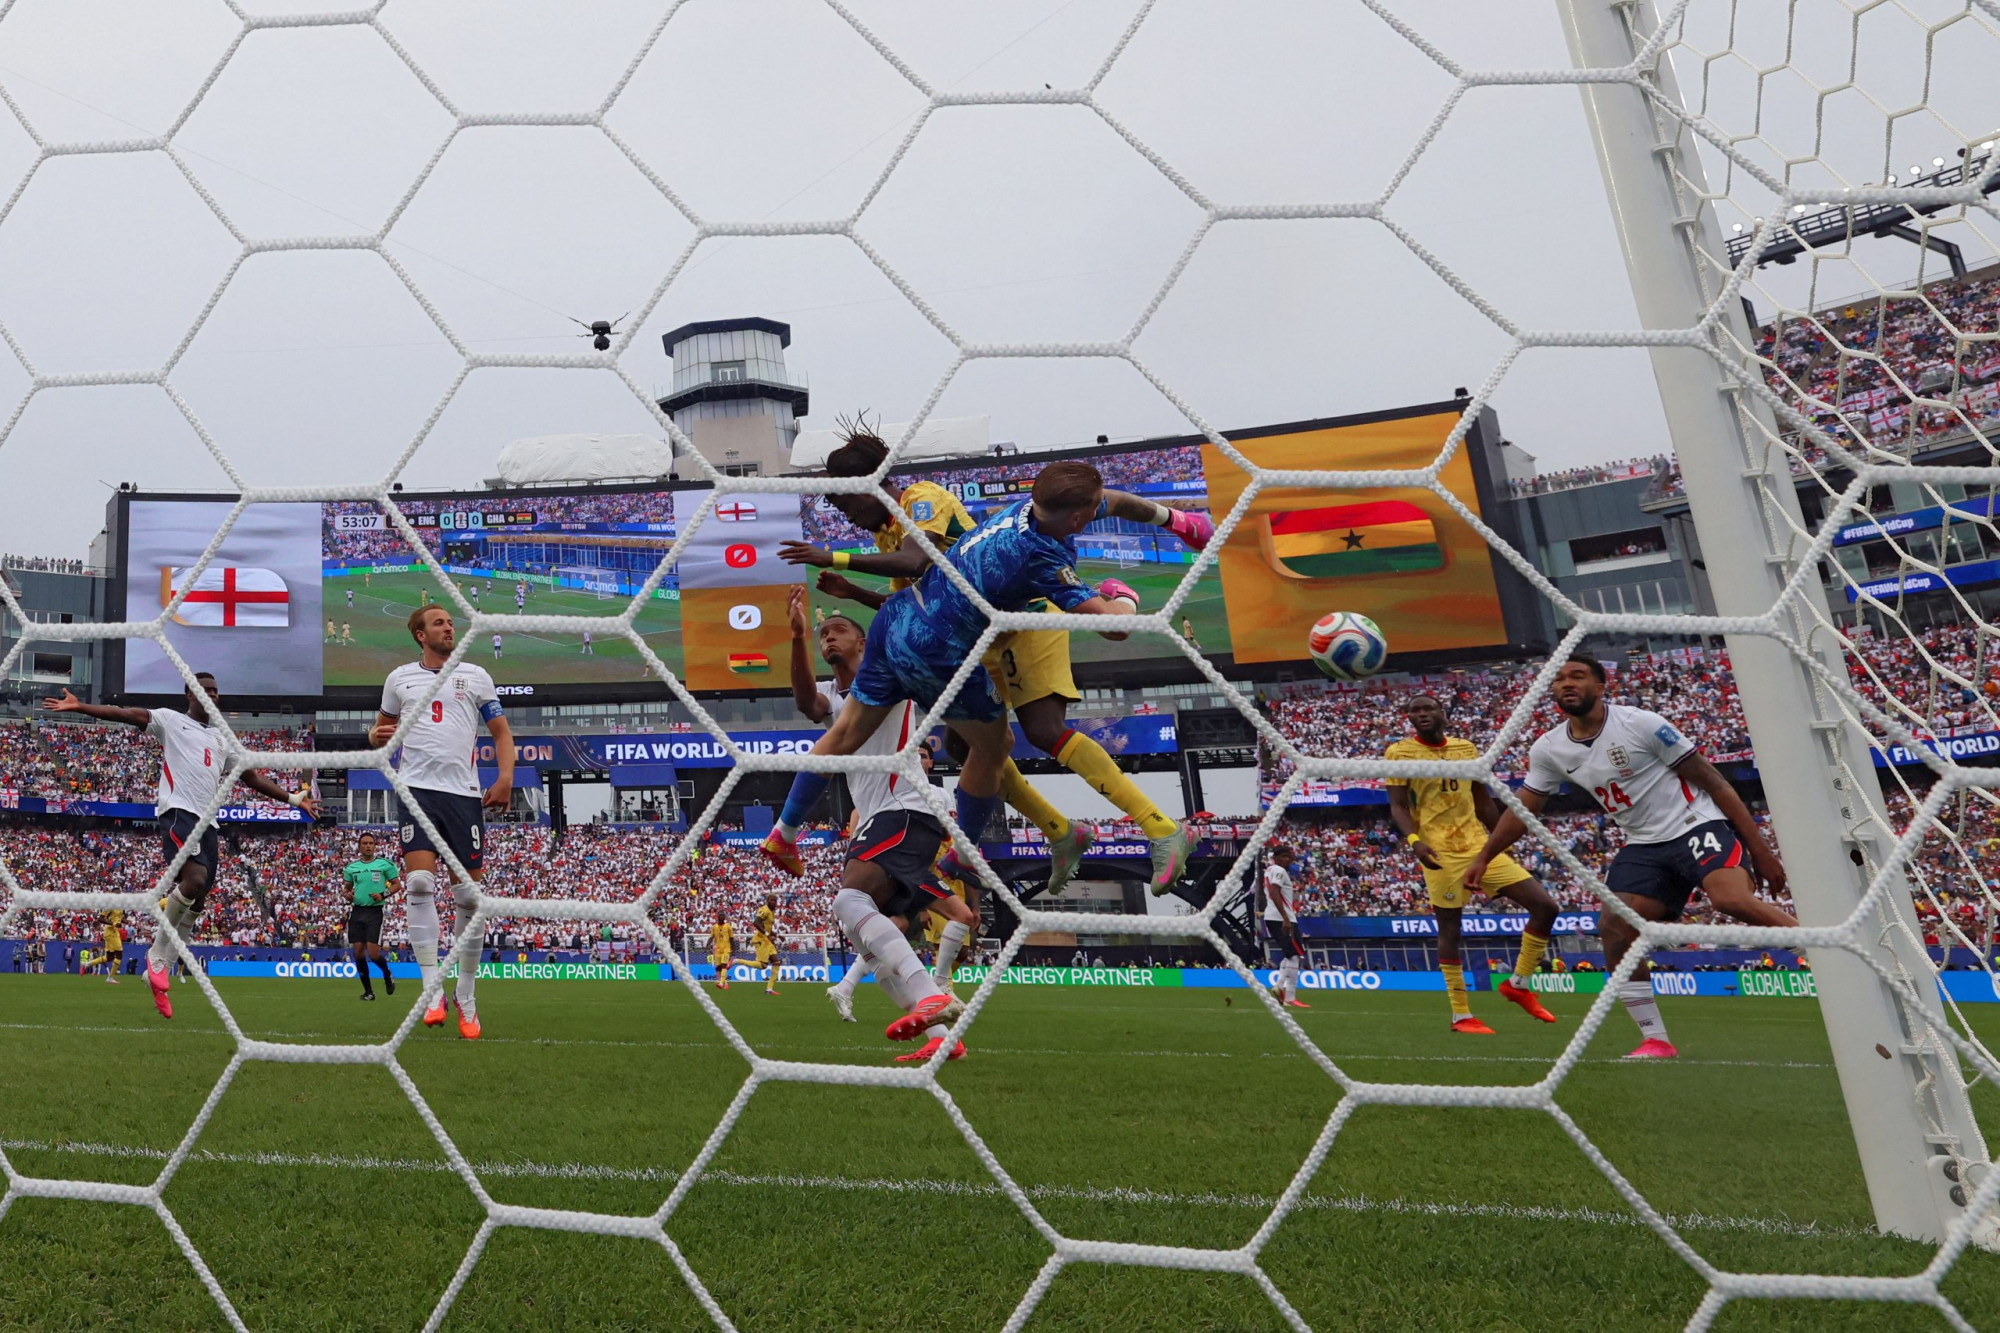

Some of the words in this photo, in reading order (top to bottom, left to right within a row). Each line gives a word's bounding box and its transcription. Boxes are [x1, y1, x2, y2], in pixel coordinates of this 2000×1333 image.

[968, 486, 975, 496] 0
[984, 483, 1006, 494] GHA
[342, 517, 377, 527] 53:07
[418, 516, 435, 526] ENG
[443, 516, 450, 526] 0
[472, 515, 479, 525] 0
[486, 514, 505, 524] GHA
[1843, 518, 1914, 540] #FIFAWrldCup
[1103, 549, 1144, 560] aramco
[373, 565, 408, 574] aramco
[449, 566, 472, 575] aramco
[584, 581, 618, 591] aramco
[432, 700, 443, 723] 9
[605, 743, 649, 760] FIFA
[651, 742, 727, 759] WORLD
[777, 739, 818, 755] 20
[204, 748, 212, 767] 6
[1595, 781, 1633, 813] 24
[229, 809, 255, 820] CUP
[471, 824, 481, 850] 9
[726, 838, 743, 846] FIFA
[1012, 846, 1035, 856] FIFA
[1105, 845, 1147, 855] 2026
[1688, 831, 1722, 860] 24
[1391, 920, 1432, 933] FIFA
[275, 962, 357, 977] aramco
[503, 964, 562, 979] ENERGY
[566, 965, 637, 980] PARTNER
[999, 967, 1067, 984] ENERGY
[1071, 968, 1154, 985] PARTNER
[1531, 974, 1575, 992] aramco
[1741, 973, 1790, 996] GLOBAL
